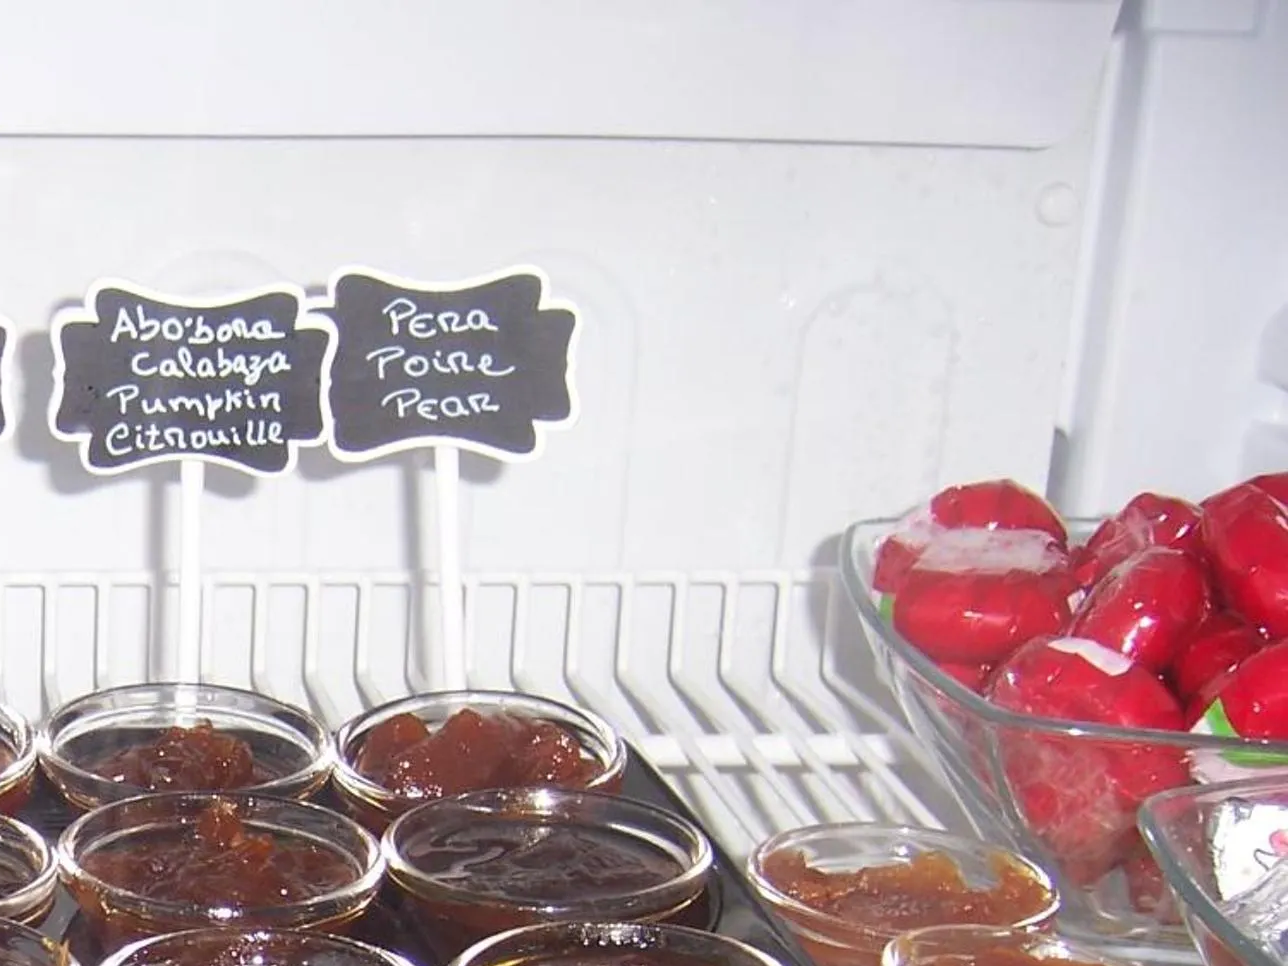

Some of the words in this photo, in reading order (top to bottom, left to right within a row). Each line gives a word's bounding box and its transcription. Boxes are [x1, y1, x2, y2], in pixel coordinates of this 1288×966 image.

[130, 345, 292, 386] Calabaza
[106, 383, 282, 421] Pumpkin
[105, 419, 284, 456] Citrouille
